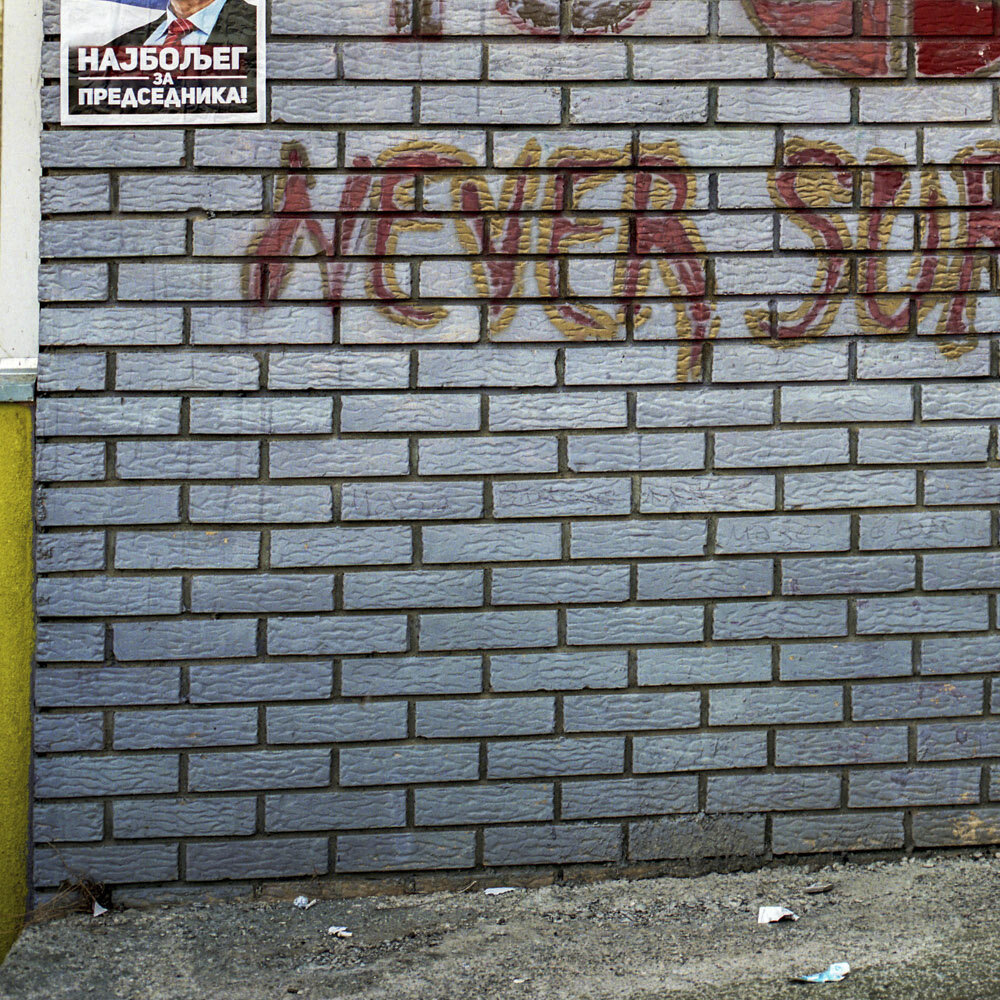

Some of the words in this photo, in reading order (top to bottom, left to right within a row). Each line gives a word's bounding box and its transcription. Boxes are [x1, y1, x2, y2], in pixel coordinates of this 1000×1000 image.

[77, 47, 248, 71] НАЈБОЉЕГ
[152, 72, 174, 86] ЗА
[77, 86, 248, 108] ПРЕДСЕДНИКА!
[242, 128, 720, 384] NEVER
